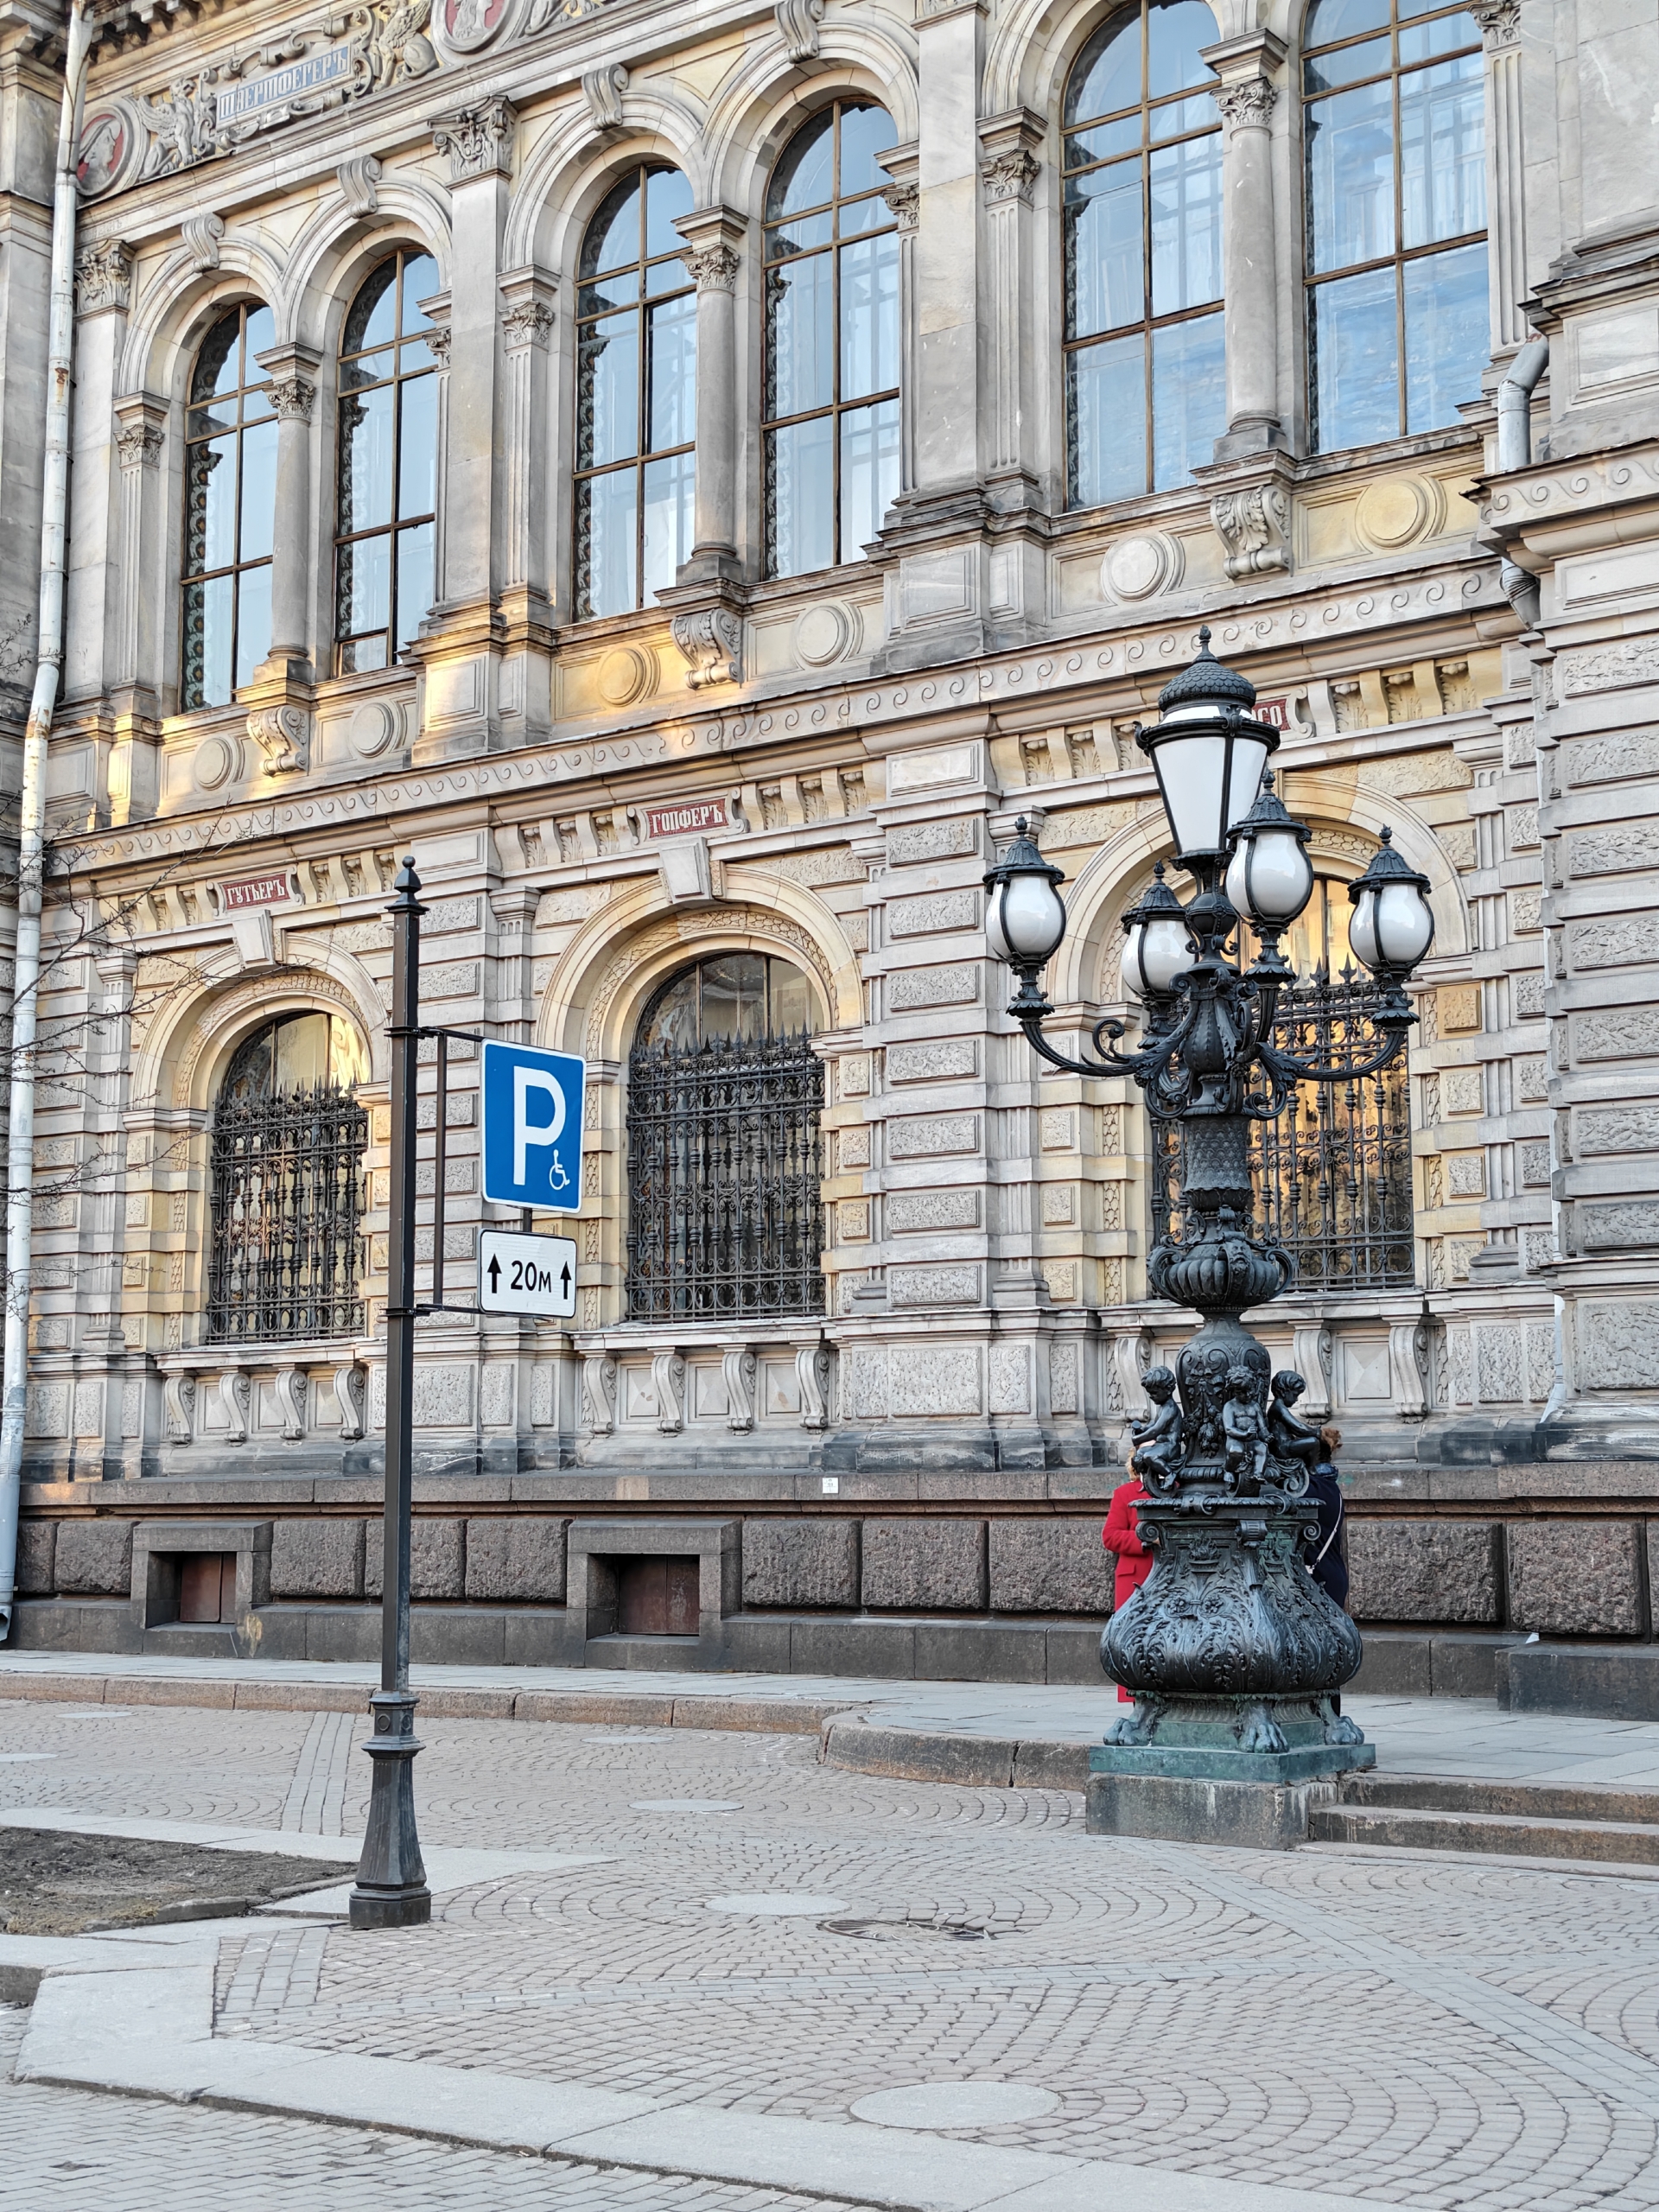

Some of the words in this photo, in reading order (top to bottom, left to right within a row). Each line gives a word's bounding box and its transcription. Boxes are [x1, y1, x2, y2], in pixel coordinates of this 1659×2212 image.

[652, 804, 723, 834] ГОПФЕРЪ
[226, 879, 285, 906] ГУТЬЕРЪ
[513, 1065, 567, 1186] P
